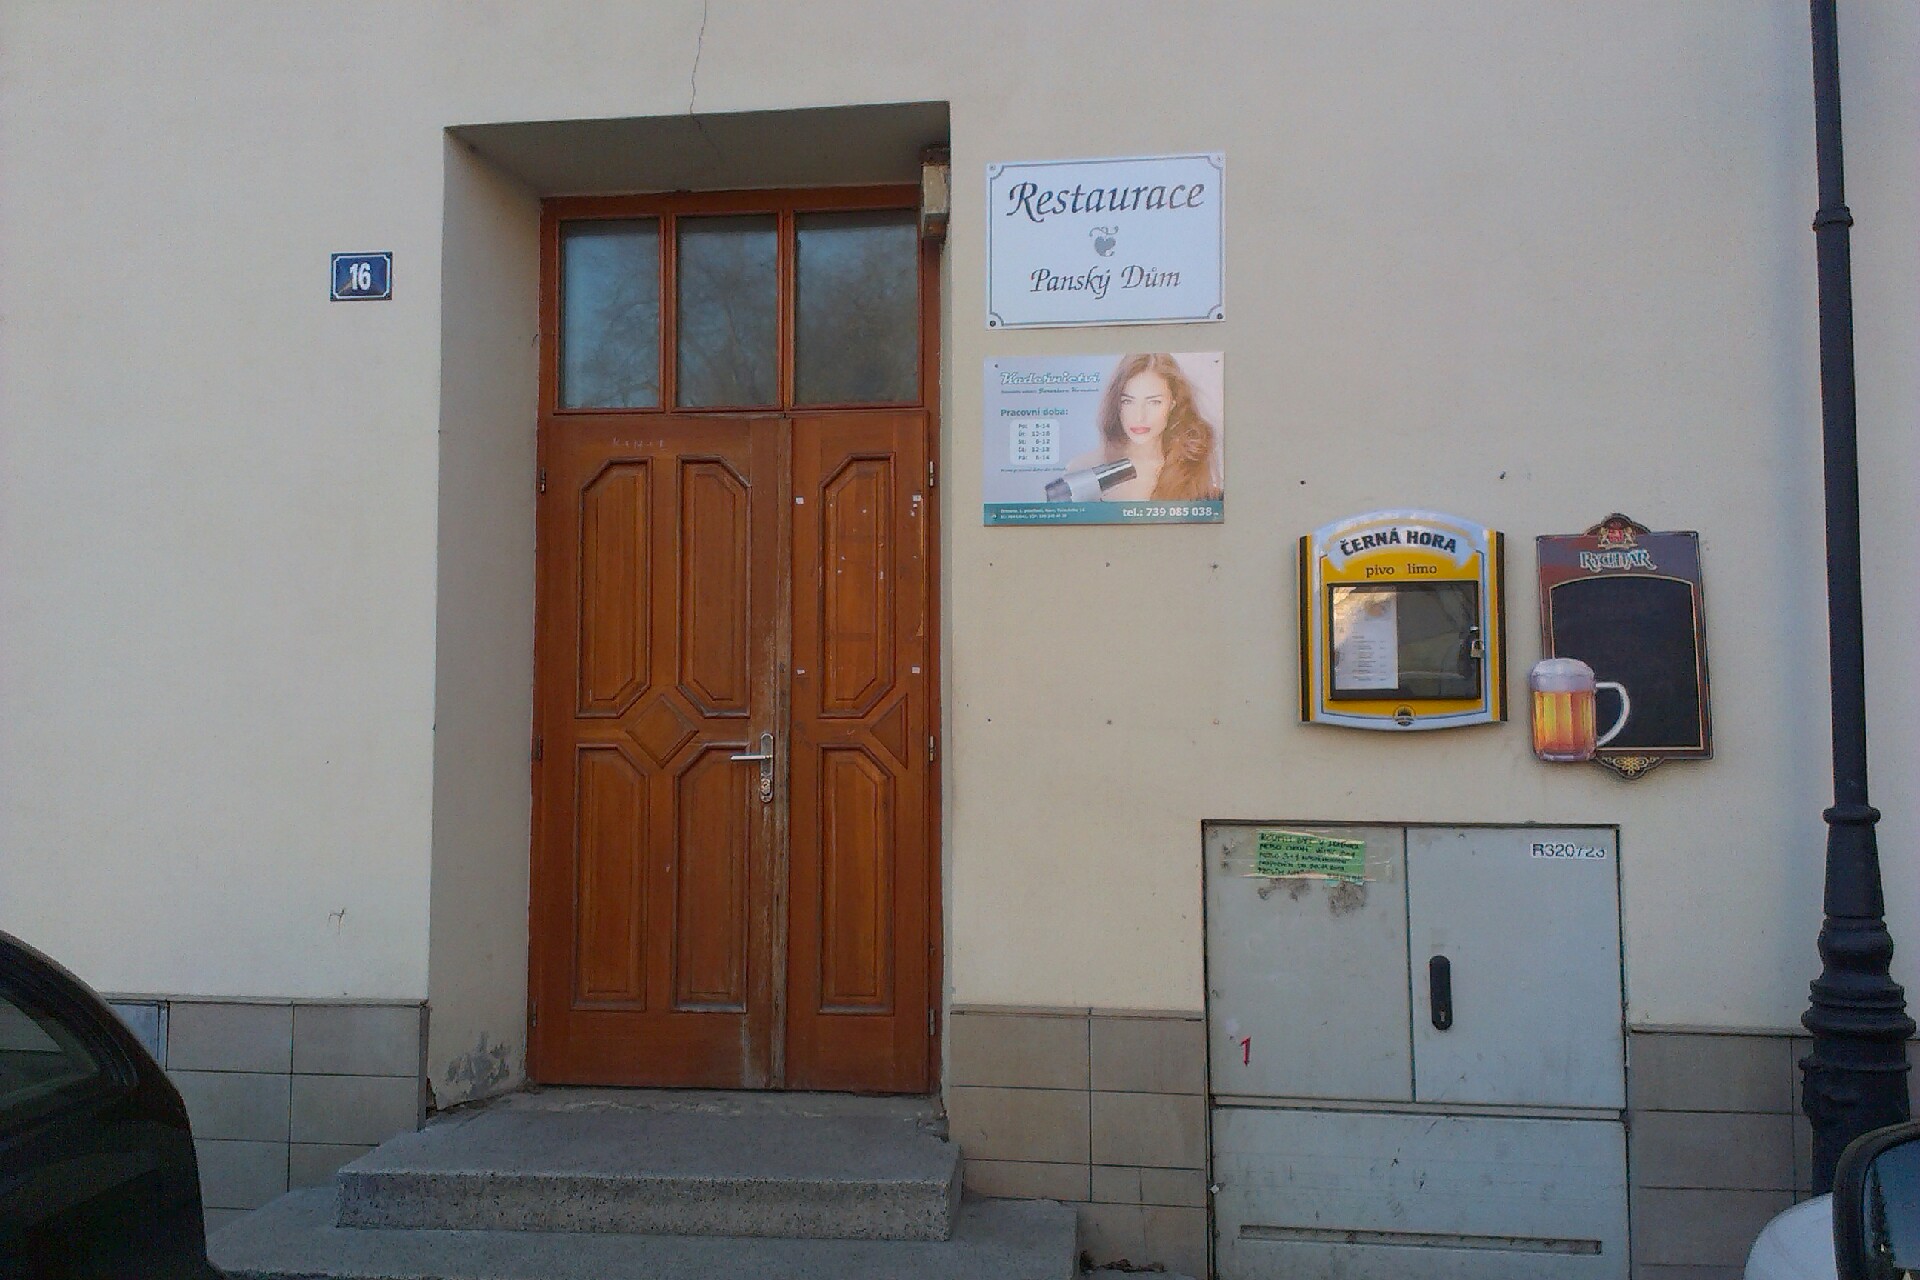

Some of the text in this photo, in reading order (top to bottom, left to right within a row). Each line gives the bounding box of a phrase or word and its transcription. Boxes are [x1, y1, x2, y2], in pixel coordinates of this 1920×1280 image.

[1006, 181, 1205, 223] Restaurace
[349, 262, 371, 291] 16
[1029, 264, 1182, 300] Panský Dům
[1000, 407, 1069, 417] Pracovní doba:
[1122, 506, 1213, 517] tel.: 739 085 038
[1340, 528, 1457, 557] ČERNÁ HORA
[1366, 563, 1438, 579] pivo limo
